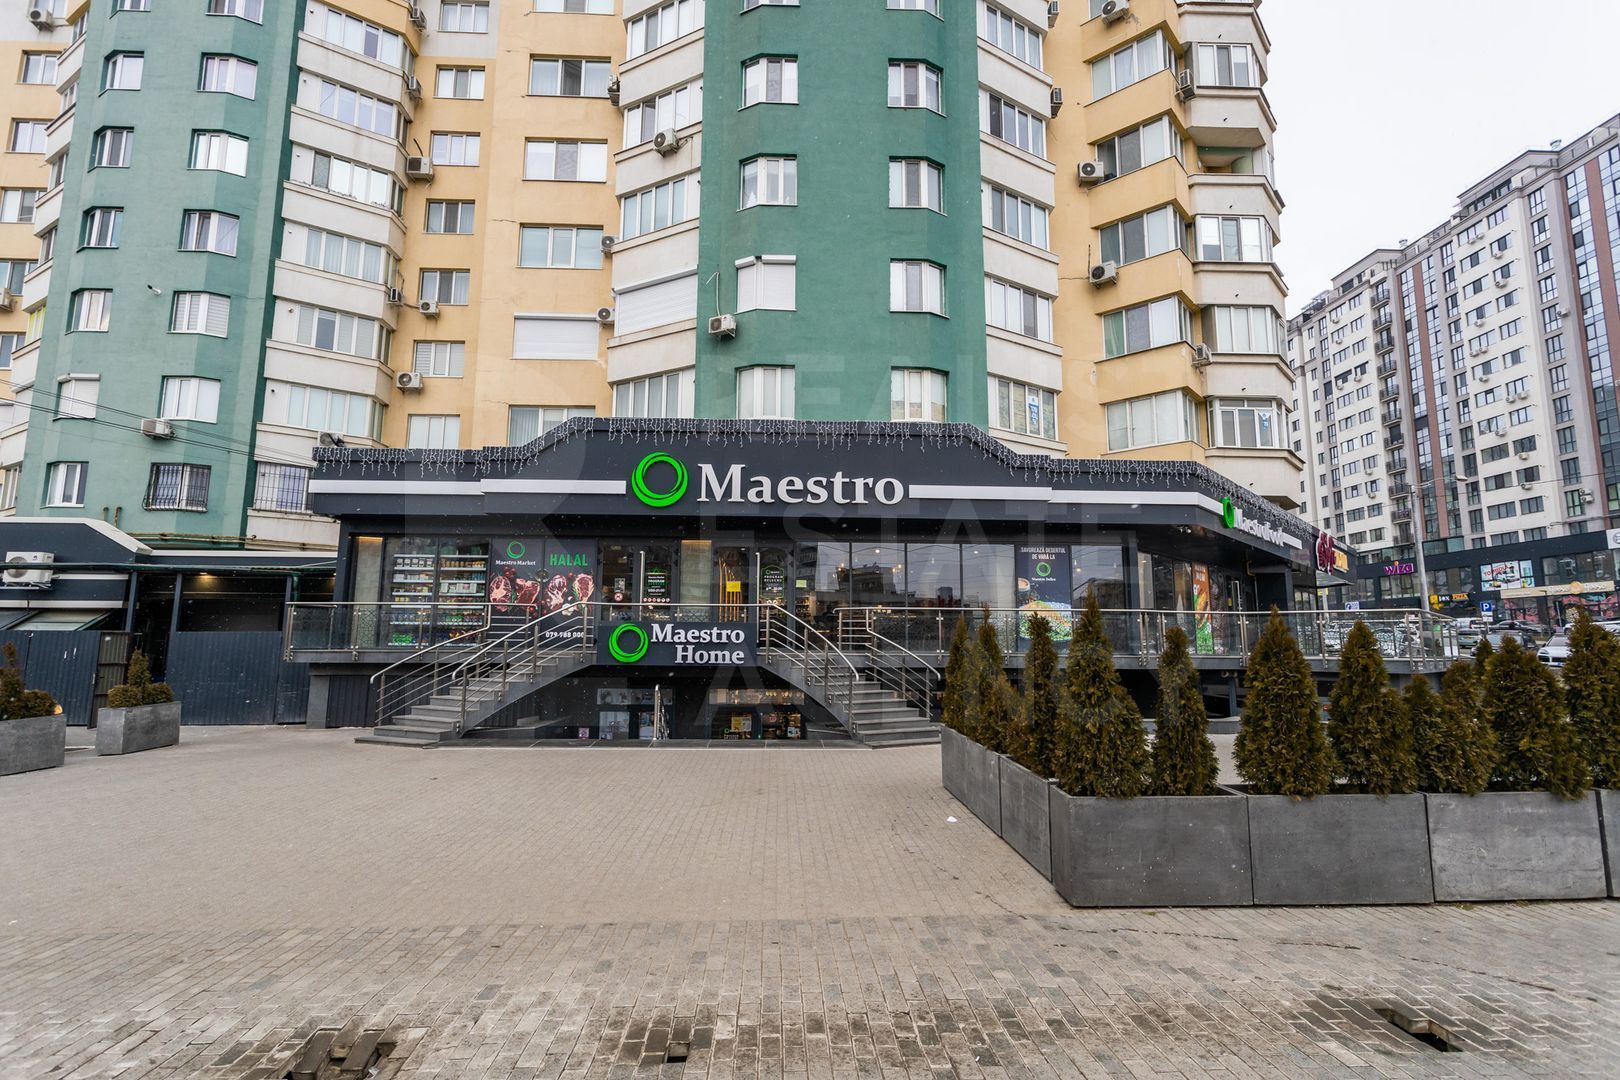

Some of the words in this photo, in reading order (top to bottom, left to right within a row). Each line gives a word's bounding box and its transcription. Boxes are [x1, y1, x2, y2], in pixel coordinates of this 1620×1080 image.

[698, 463, 905, 504] Maestro
[549, 553, 588, 566] HALAL
[1483, 603, 1490, 611] P
[651, 623, 745, 644] Maestro
[674, 645, 745, 665] Home
